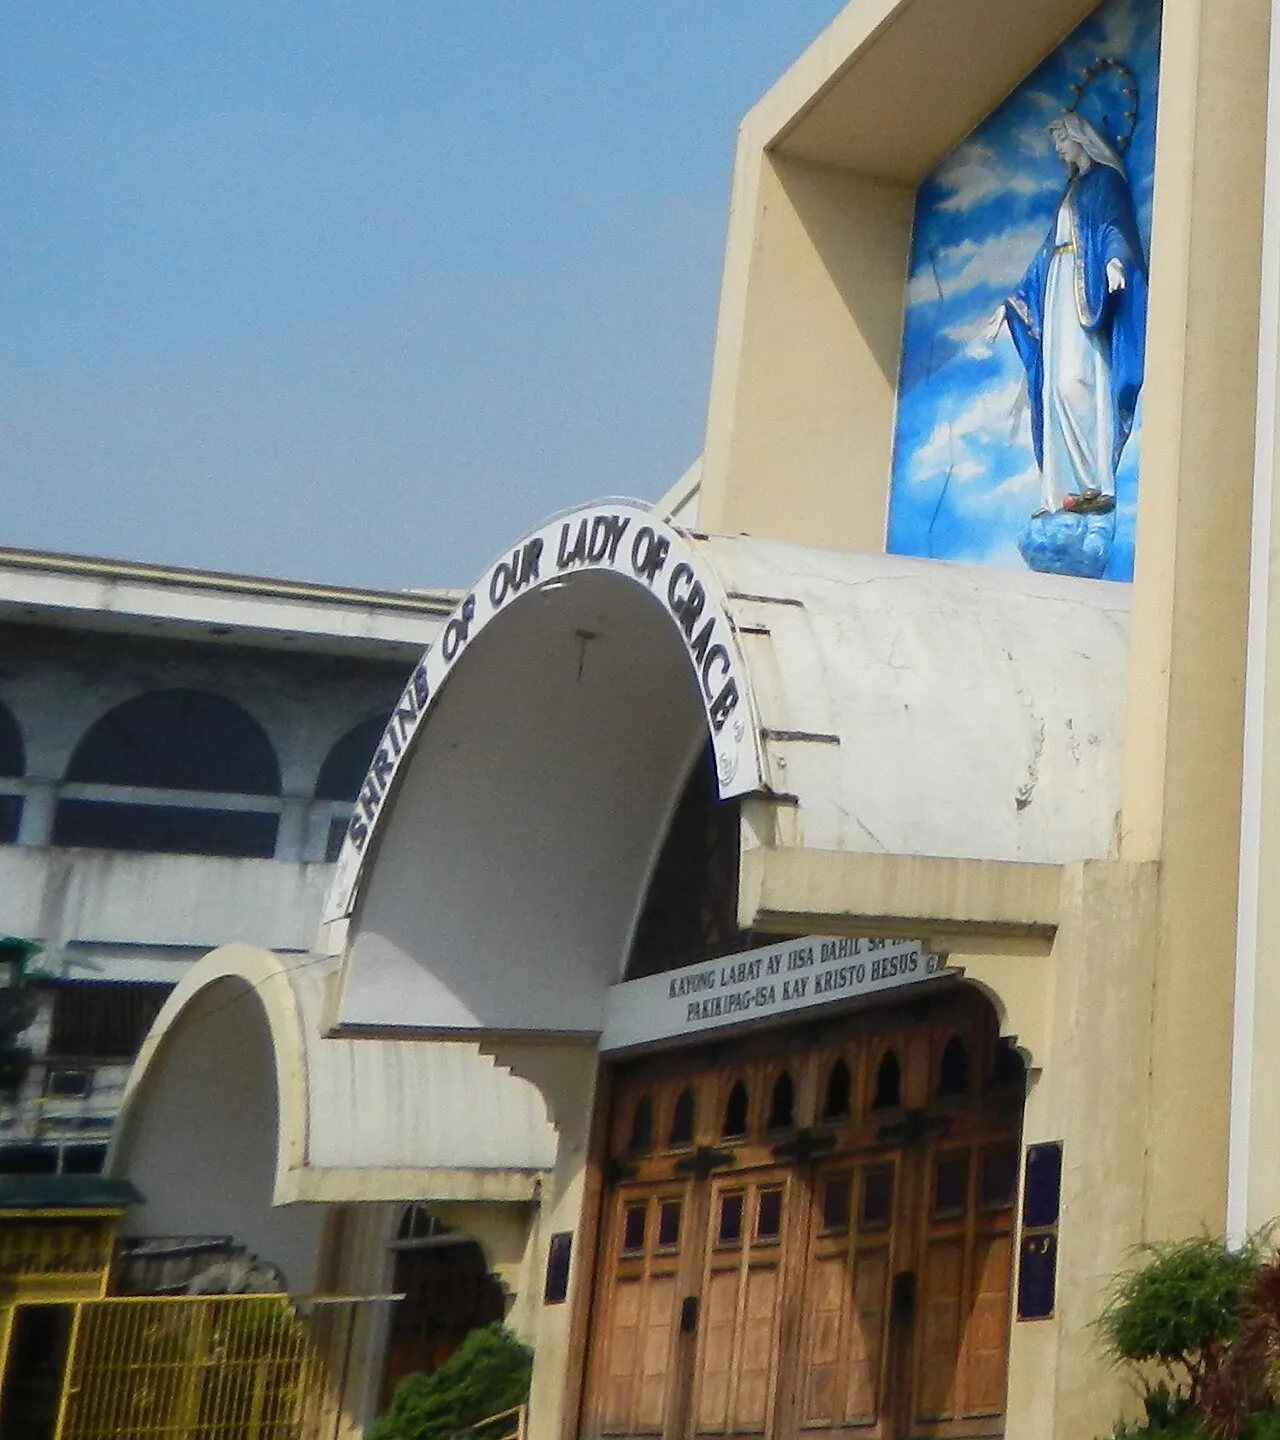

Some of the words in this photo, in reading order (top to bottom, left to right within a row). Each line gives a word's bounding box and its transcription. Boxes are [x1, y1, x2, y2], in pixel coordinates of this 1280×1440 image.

[350, 663, 430, 856] SHRINE
[442, 593, 476, 664] OF
[489, 537, 544, 609] OUR
[556, 514, 632, 569] LADY
[631, 526, 671, 584] OF
[667, 562, 740, 733] GRACE
[765, 953, 785, 976] AY
[787, 946, 814, 971] IISA
[820, 938, 861, 962] DAHIL
[782, 976, 810, 1001] KAY
[813, 963, 866, 995] KRISTO
[871, 950, 918, 984] HESUS
